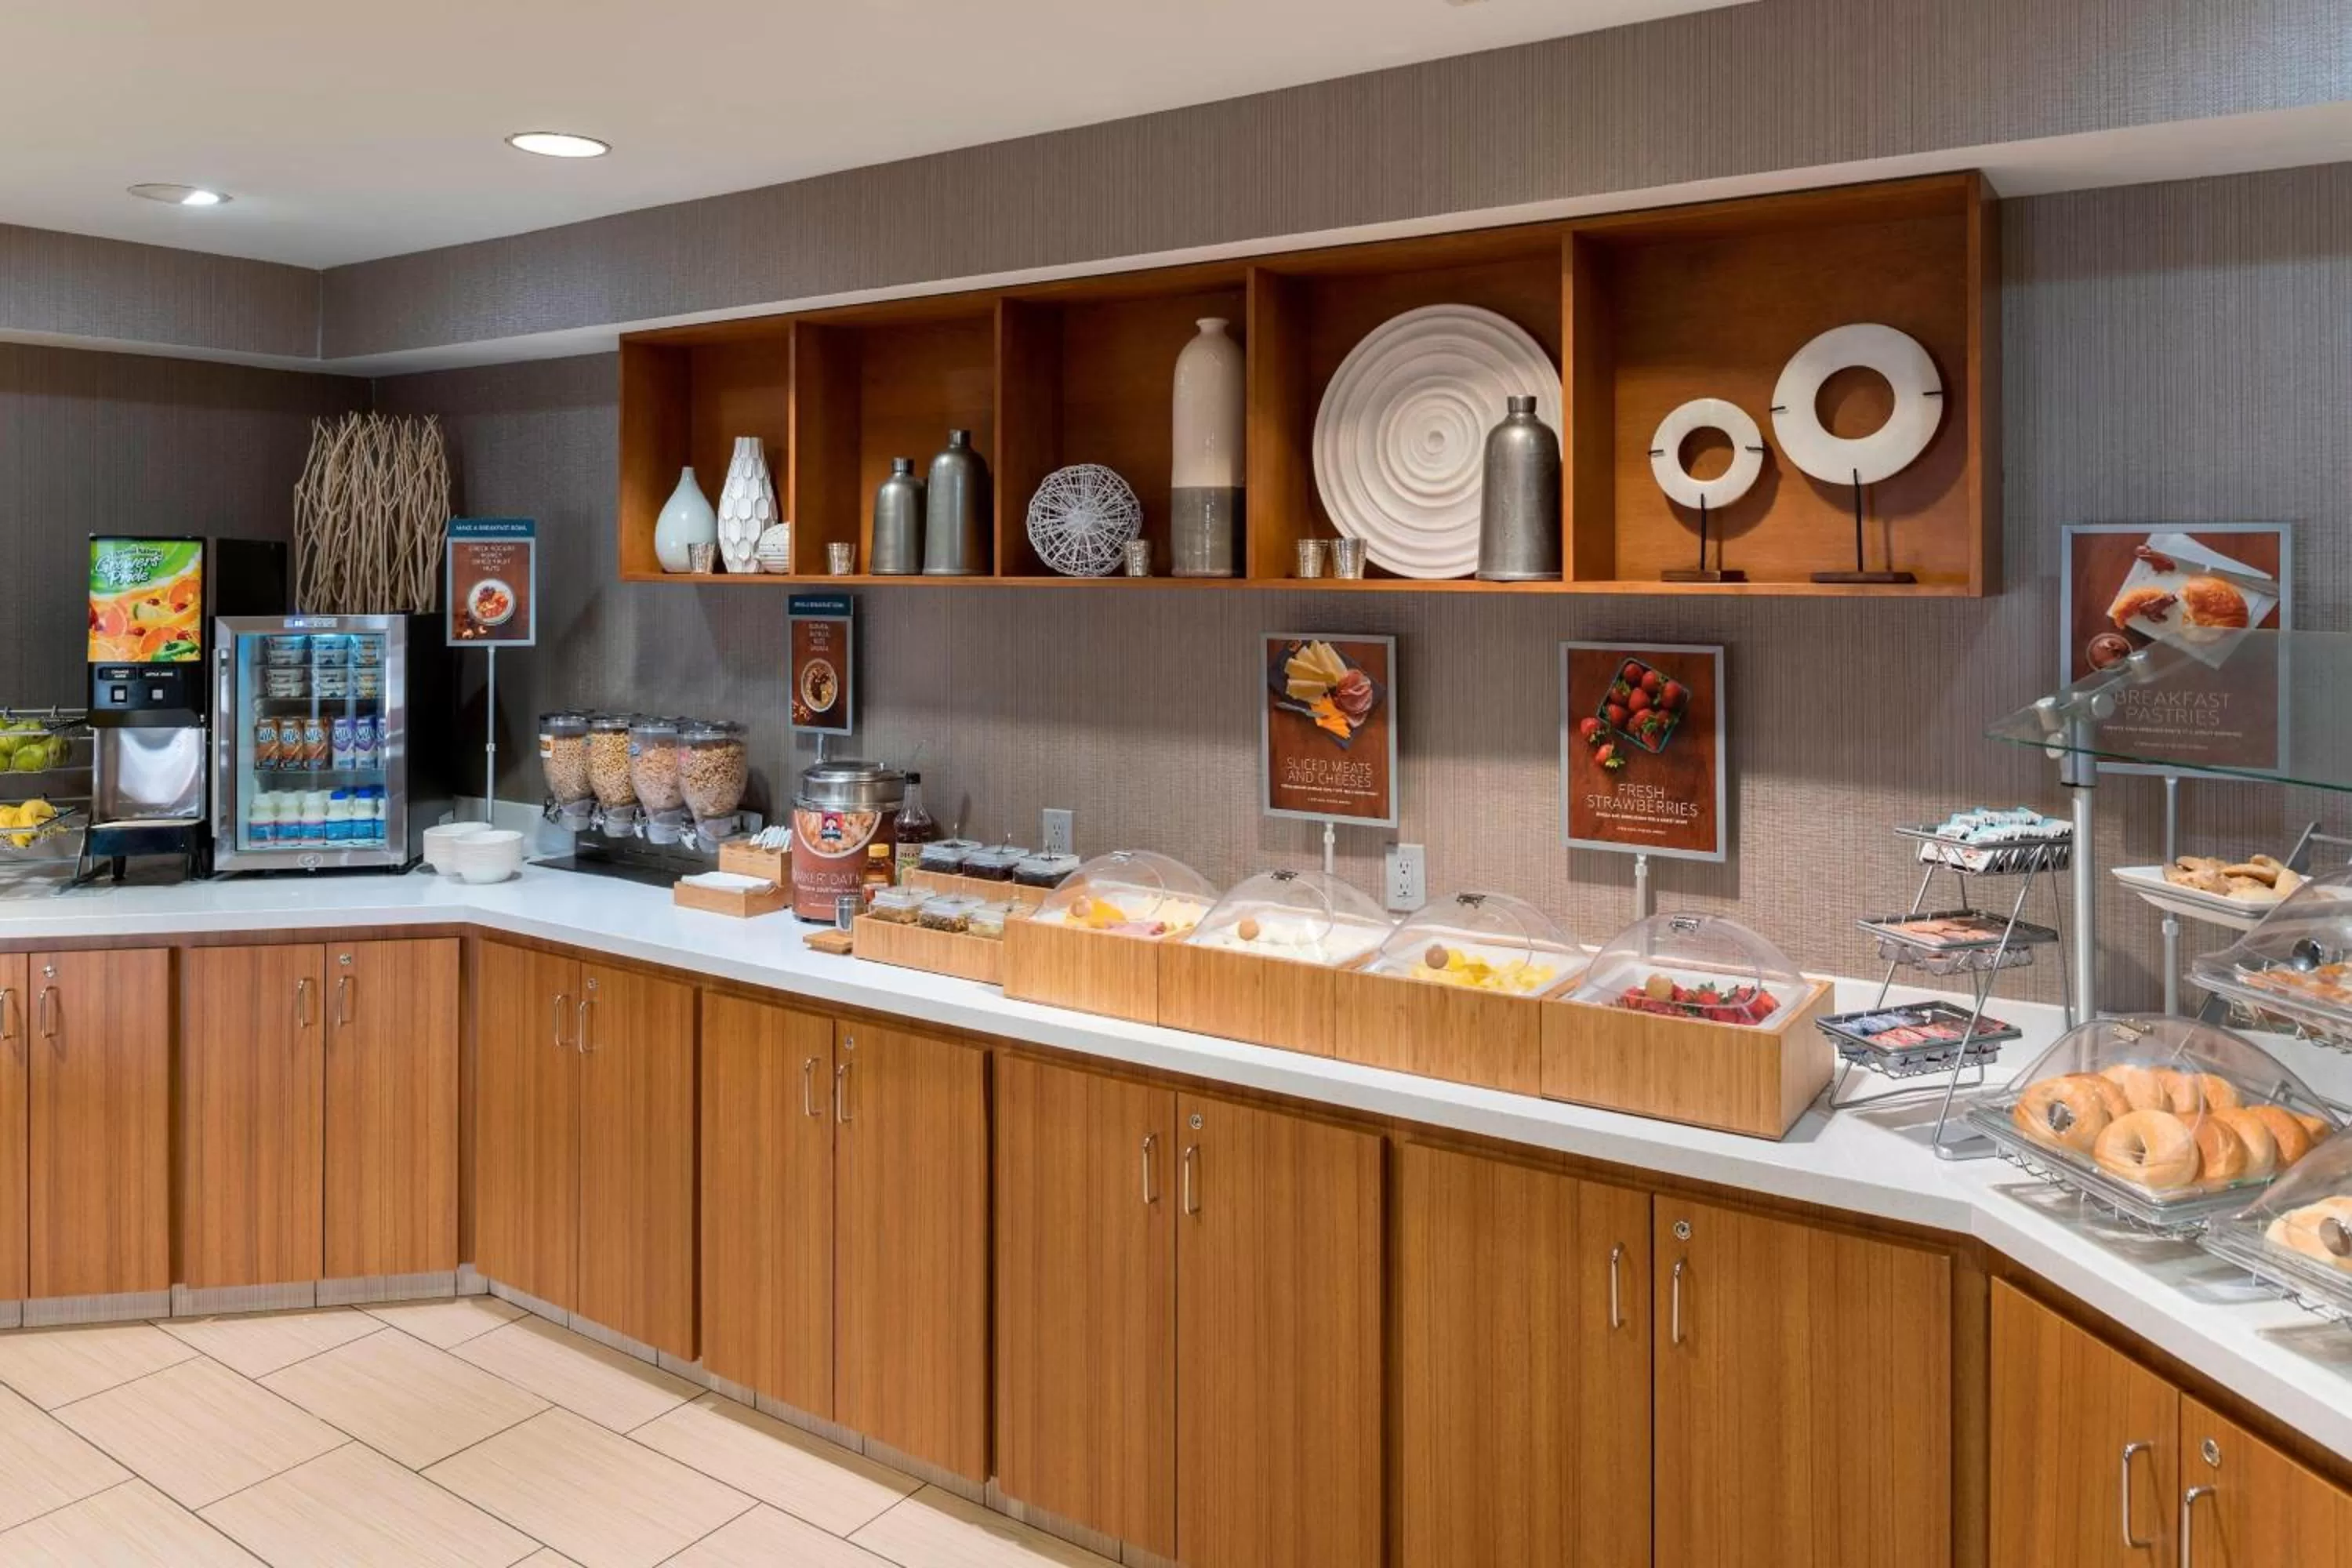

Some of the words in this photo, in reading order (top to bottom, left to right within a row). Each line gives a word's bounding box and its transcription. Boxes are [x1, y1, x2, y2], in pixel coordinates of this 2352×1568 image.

[2114, 689, 2231, 709] BREAKFAST
[2125, 706, 2220, 727] PASTRIES
[1287, 758, 1327, 772] SLICED
[1331, 760, 1372, 775] MEATS
[1288, 770, 1315, 783] AND
[1318, 772, 1372, 788] CHEESES
[1618, 783, 1664, 800] FRESH
[1587, 794, 1699, 818] STRAWBERRIES
